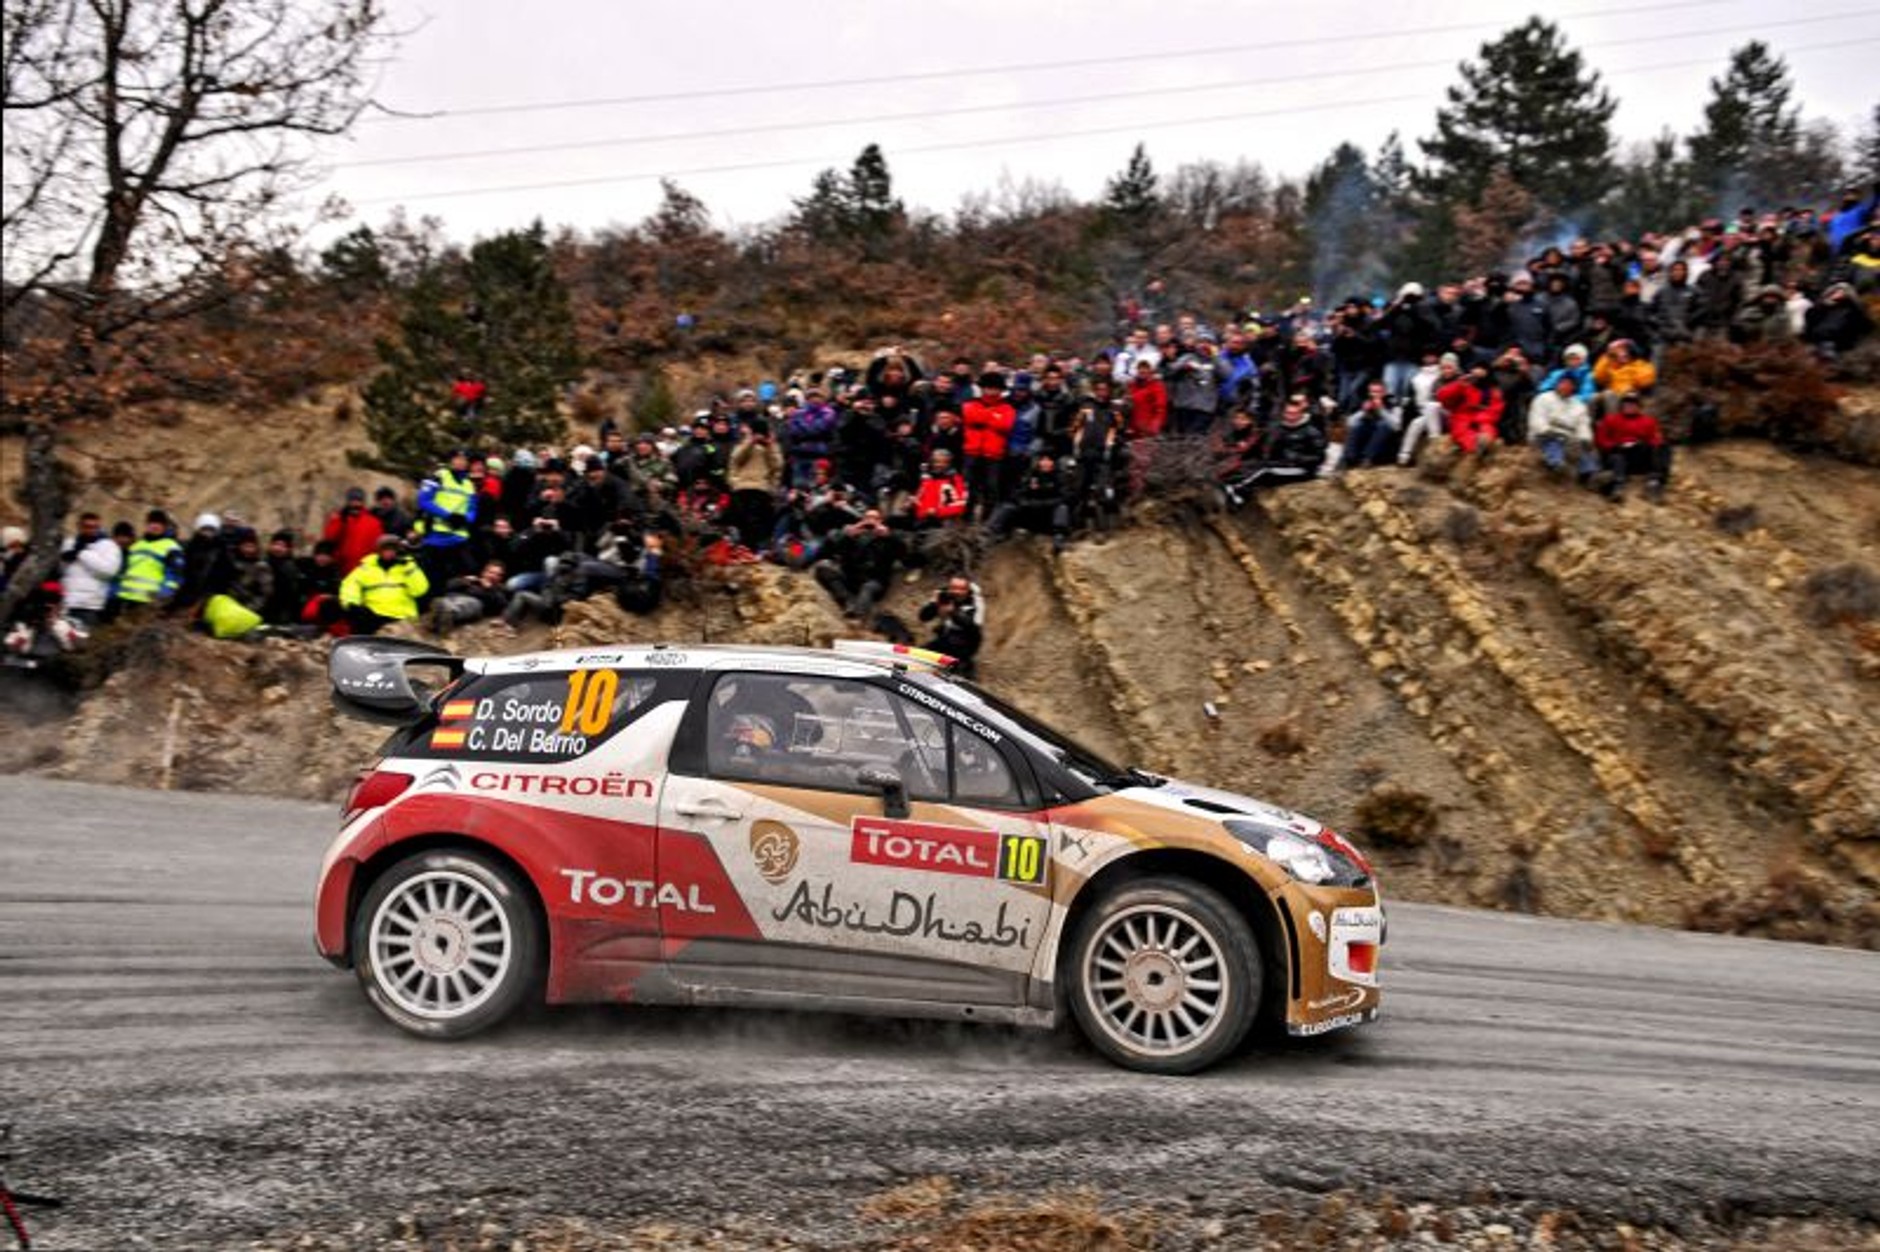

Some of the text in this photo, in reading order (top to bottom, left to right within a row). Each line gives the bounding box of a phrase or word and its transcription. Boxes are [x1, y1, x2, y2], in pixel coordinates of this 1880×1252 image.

[475, 698, 562, 723] D. Sordo
[560, 668, 619, 736] 10
[467, 726, 587, 754] C. Del Barrio
[861, 826, 989, 869] TOTAL
[1006, 835, 1039, 881] 10
[560, 868, 716, 913] TOTAL
